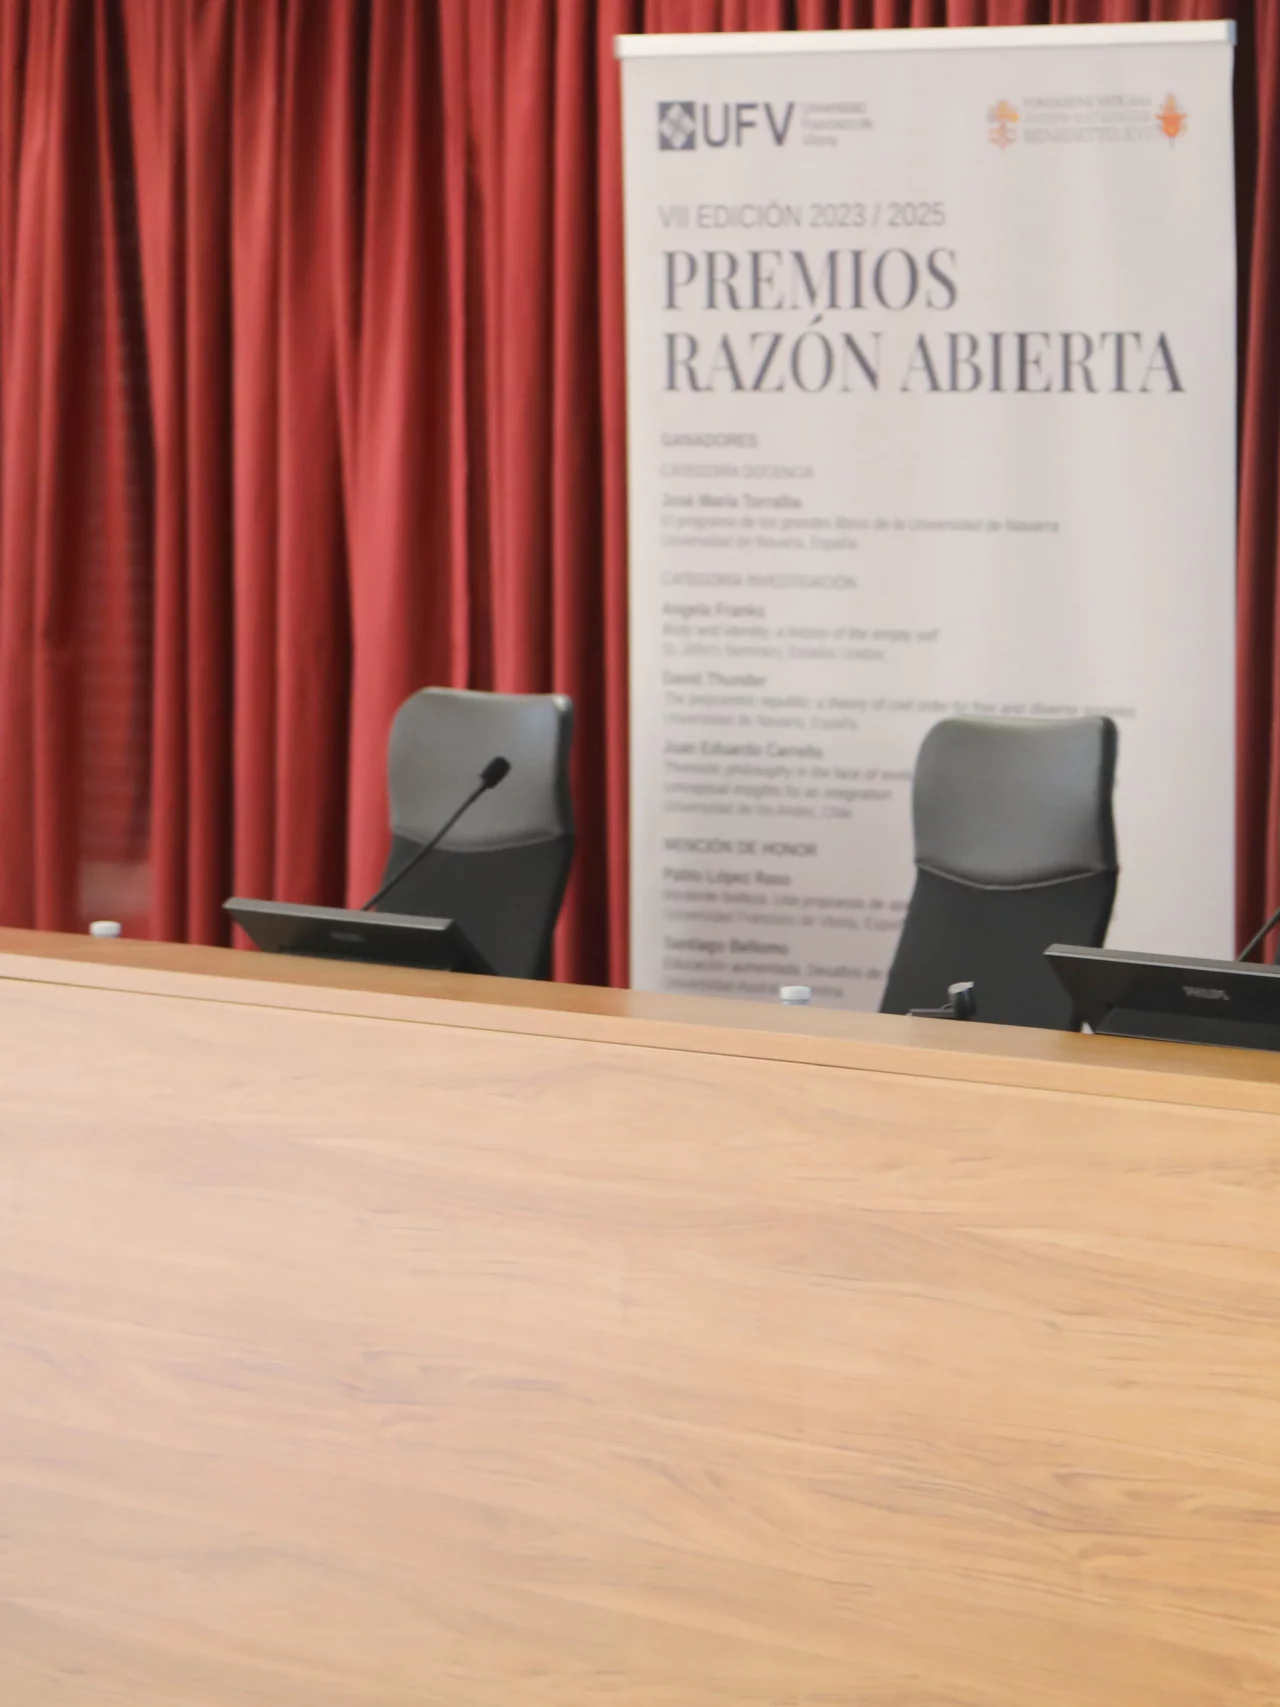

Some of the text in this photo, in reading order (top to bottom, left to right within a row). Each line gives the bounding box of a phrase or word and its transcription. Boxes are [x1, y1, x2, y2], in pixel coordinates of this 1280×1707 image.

[701, 101, 796, 149] UFV
[658, 199, 946, 229] VII EDICIÓN 2023 / 2025
[661, 247, 959, 312] PREMIOS
[662, 314, 1187, 395] RAZÓN ABIERTA
